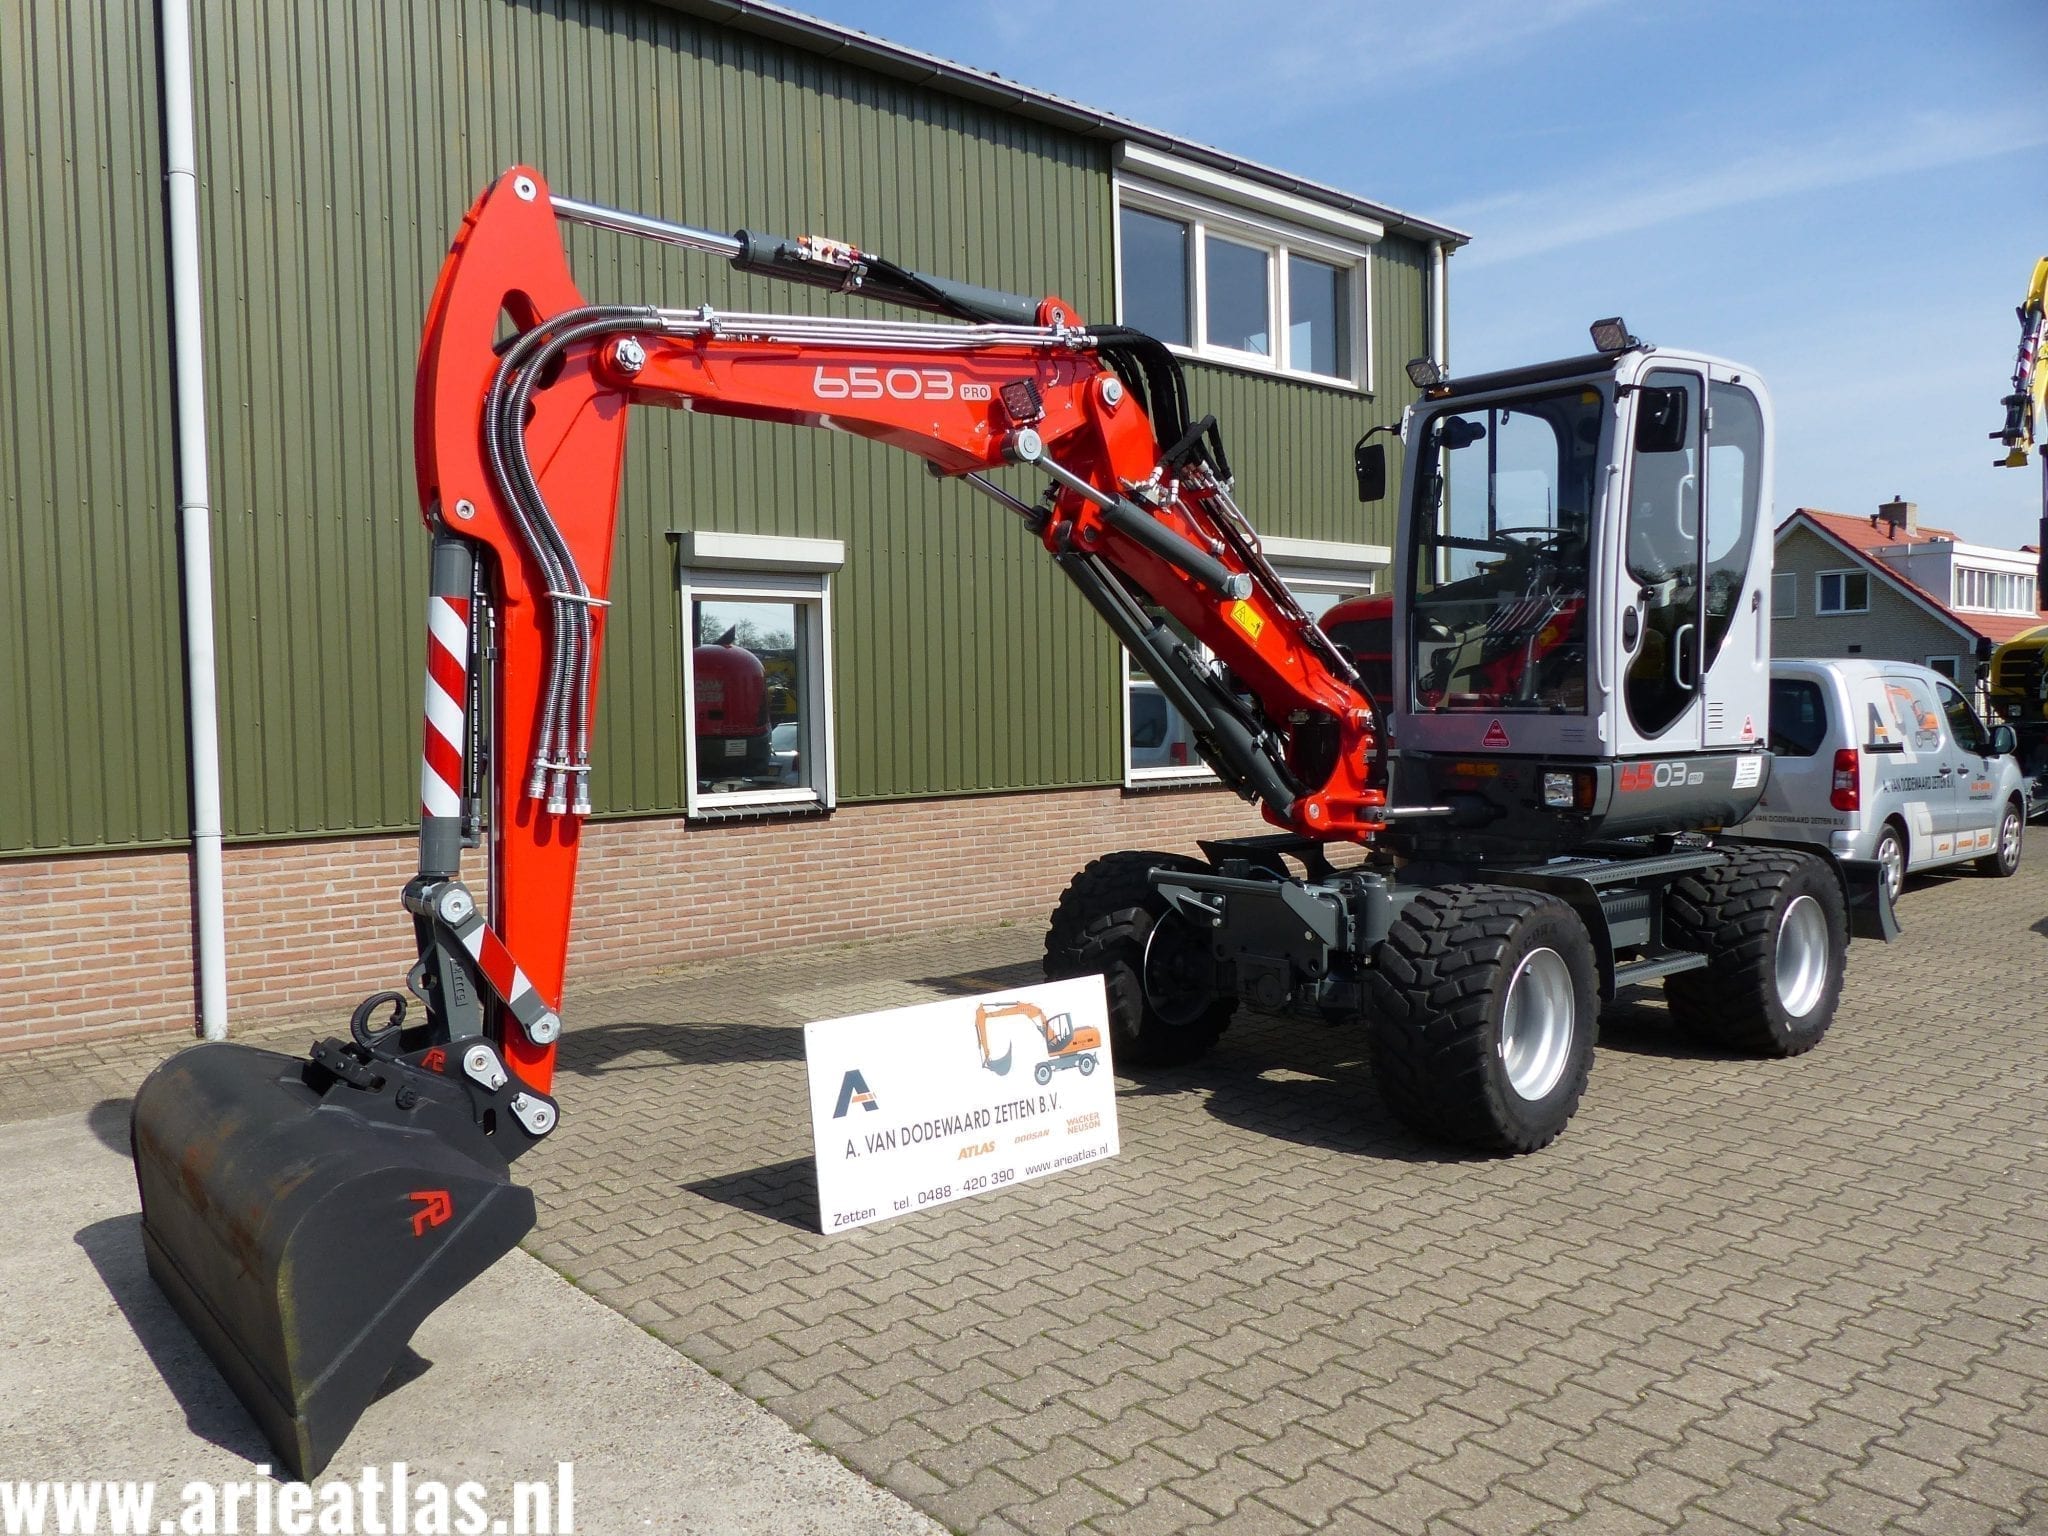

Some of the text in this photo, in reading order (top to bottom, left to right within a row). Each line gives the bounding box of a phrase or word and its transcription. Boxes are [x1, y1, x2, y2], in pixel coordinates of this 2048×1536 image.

[813, 365, 989, 399] 6503 PRO
[1619, 762, 1687, 791] 6503
[845, 1092, 1062, 1159] A. VAN DODEWAARD ZETTEN B.V.
[1066, 1112, 1100, 1127] WACKER
[1067, 1119, 1101, 1135] NEUSON
[1014, 1129, 1050, 1144] DOOSAN
[957, 1140, 996, 1160] ATLAS
[834, 1207, 876, 1226] Zetten
[917, 1185, 952, 1204] 0488
[963, 1176, 987, 1192] 420
[991, 1168, 1015, 1185] 390
